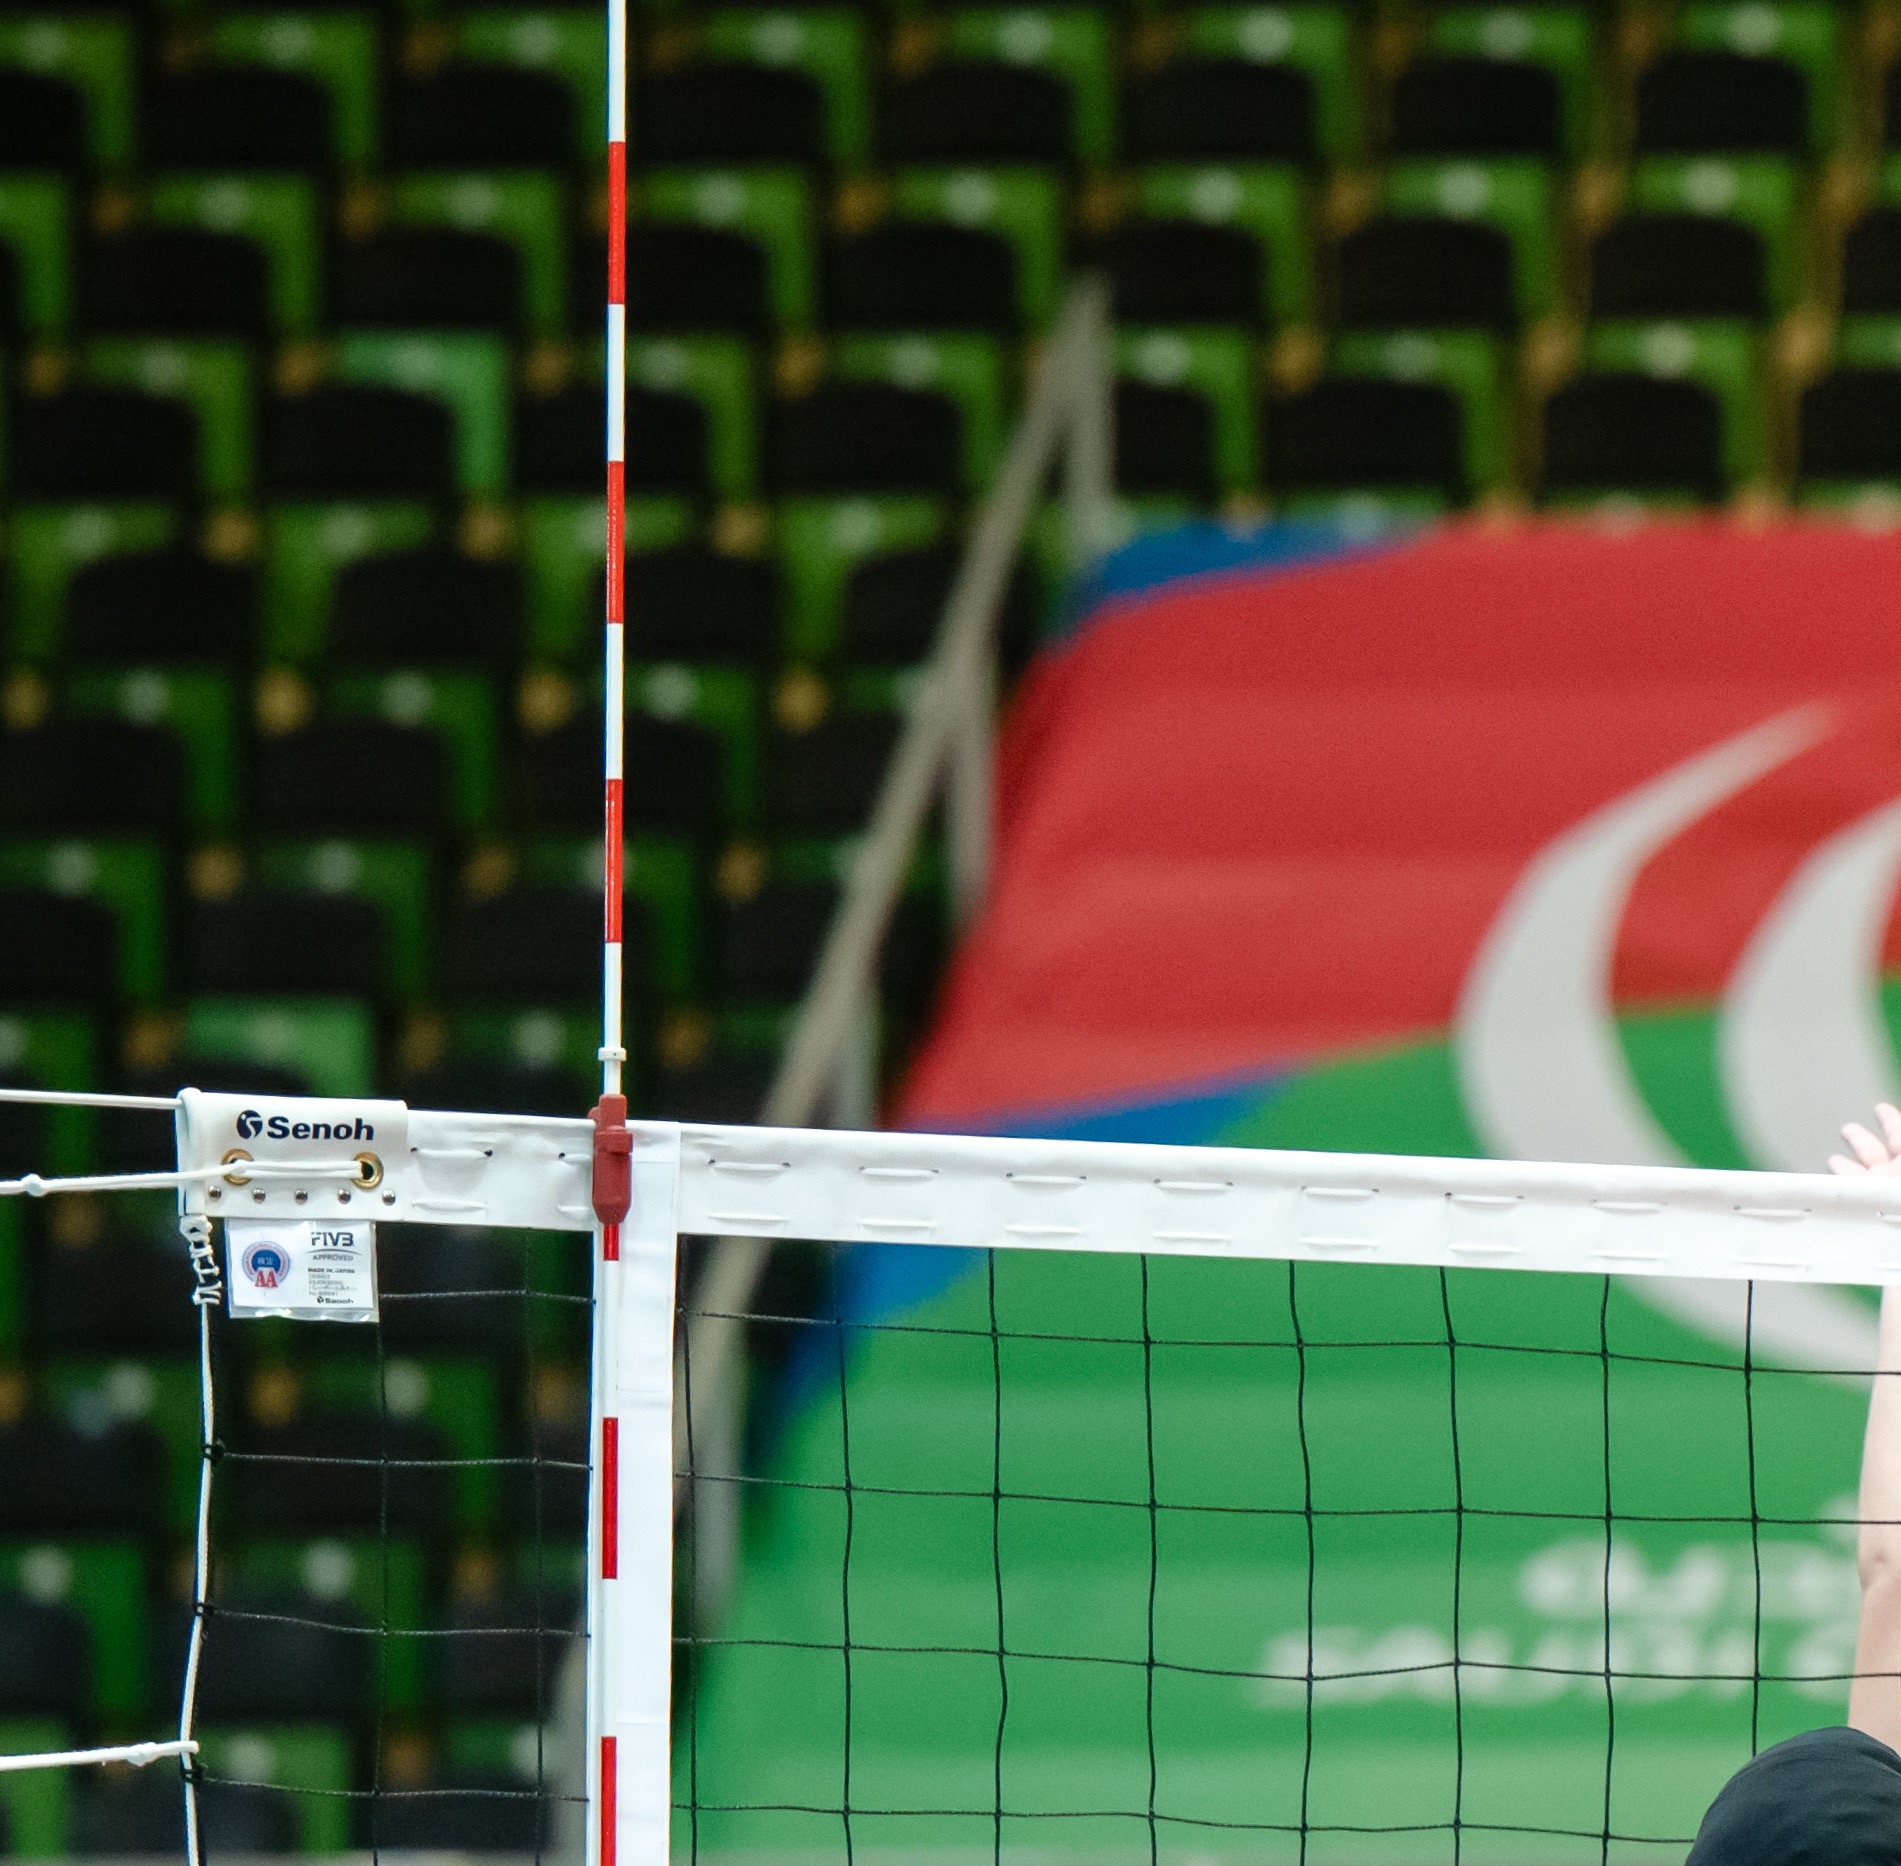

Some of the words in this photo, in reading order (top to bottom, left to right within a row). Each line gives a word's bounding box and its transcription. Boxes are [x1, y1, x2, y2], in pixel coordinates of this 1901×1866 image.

[267, 1116, 375, 1141] Senoh
[311, 1231, 355, 1247] FIVB
[312, 1253, 354, 1261] APPROVED
